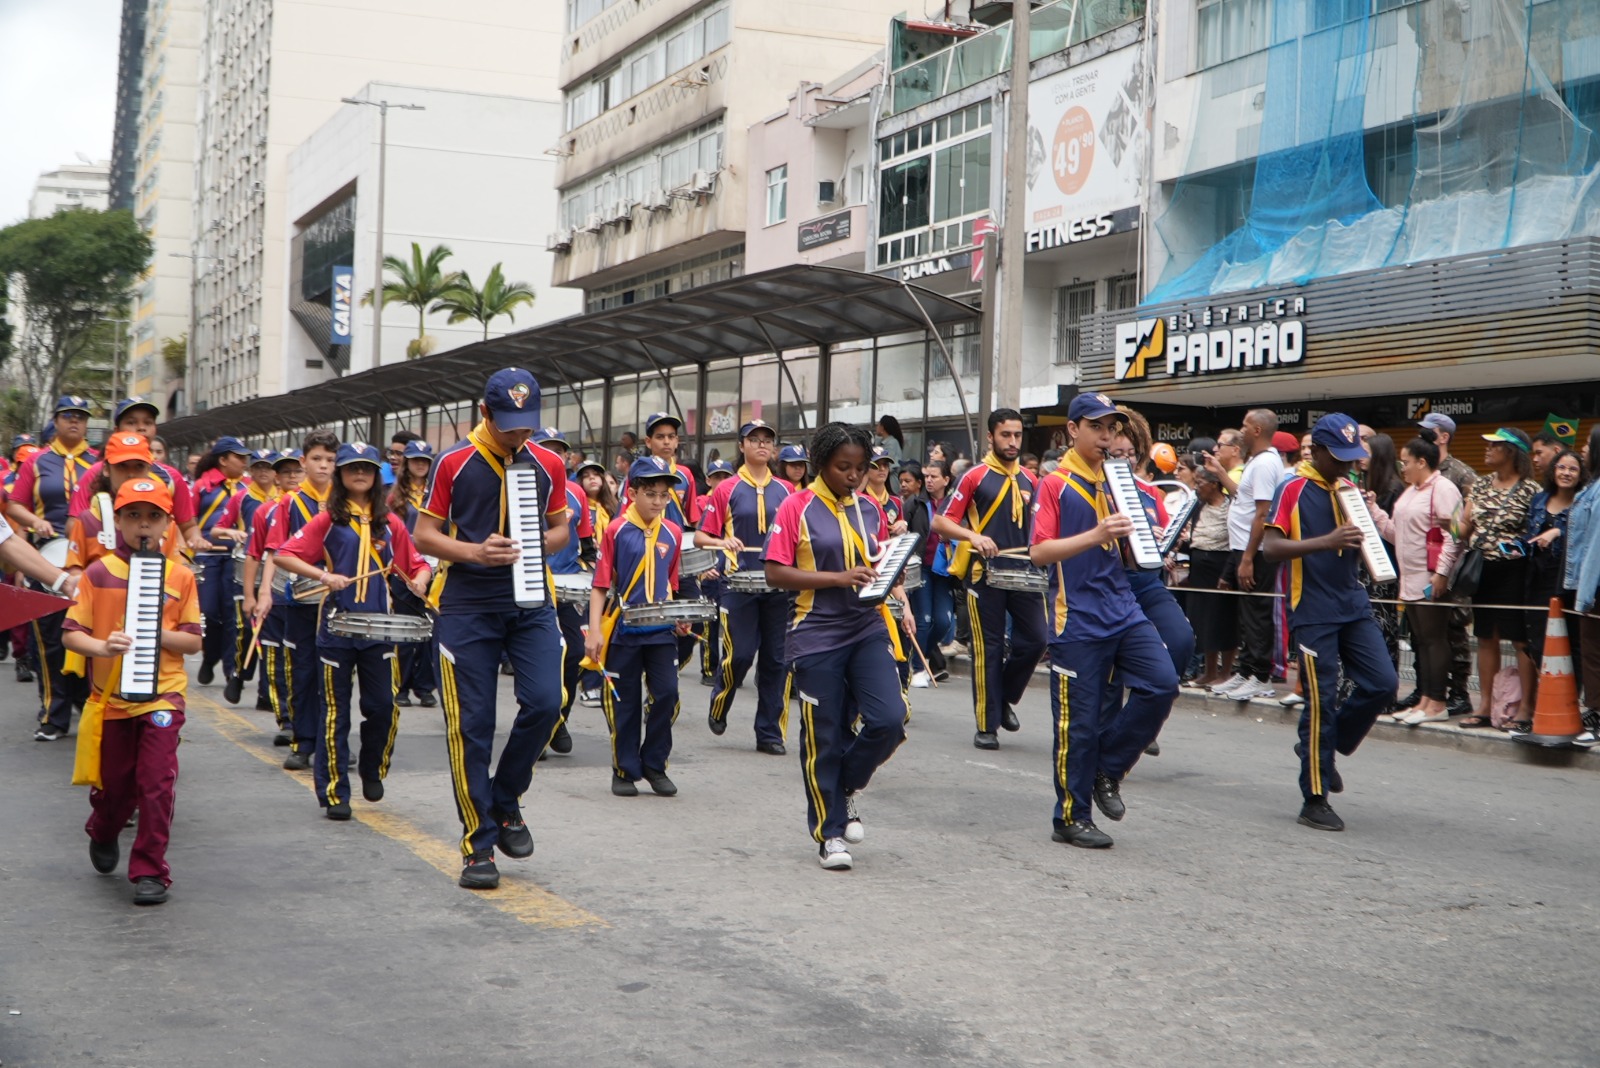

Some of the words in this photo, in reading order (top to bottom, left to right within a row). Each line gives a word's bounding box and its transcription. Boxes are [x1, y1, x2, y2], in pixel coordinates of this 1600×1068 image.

[1055, 92, 1069, 105] COM
[1069, 91, 1075, 101] A
[1075, 83, 1096, 98] GENTE
[1072, 70, 1099, 86] TREINAR
[1026, 211, 1113, 253] FITNESS
[334, 274, 352, 337] CAIXA
[1168, 297, 1305, 330] ELÉTRICA
[1166, 320, 1304, 374] PADRÃO
[1158, 422, 1193, 441] Black
